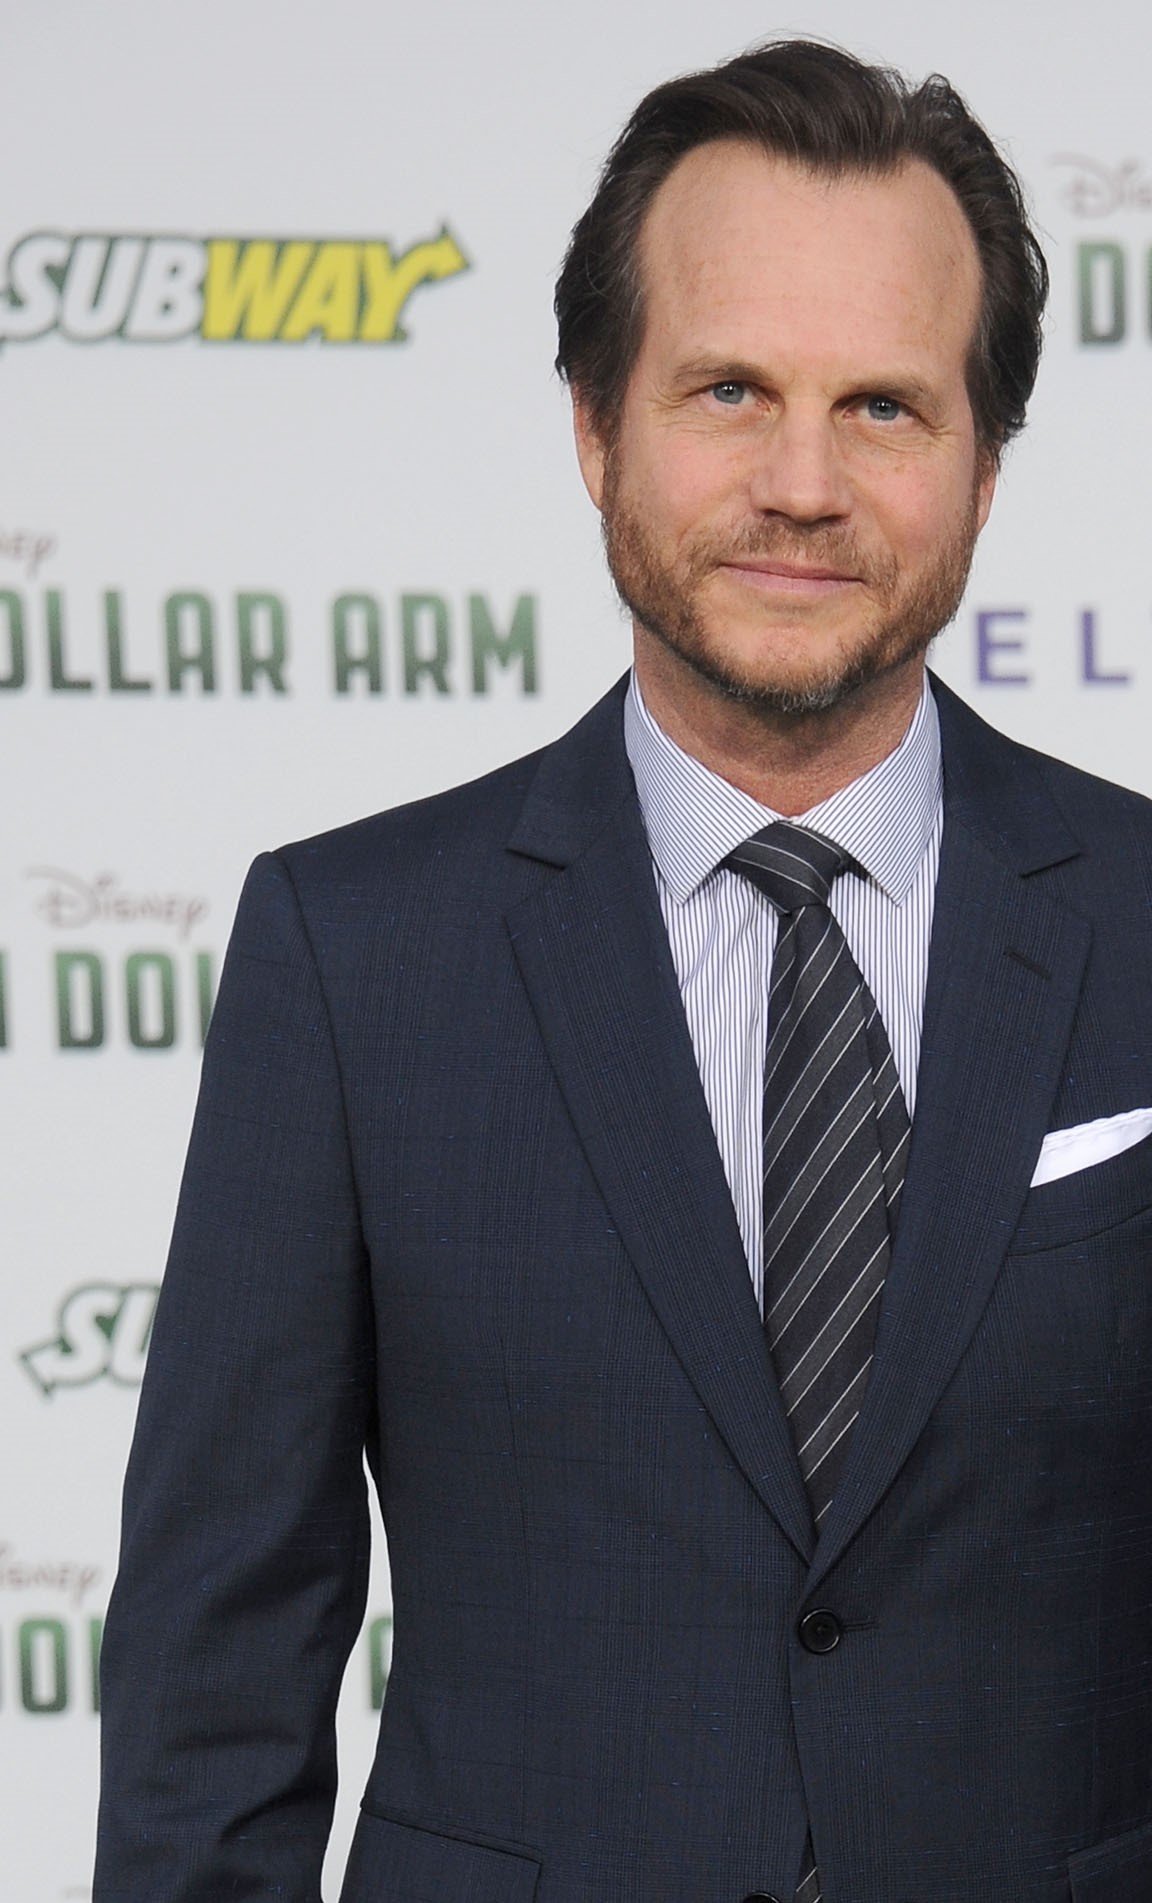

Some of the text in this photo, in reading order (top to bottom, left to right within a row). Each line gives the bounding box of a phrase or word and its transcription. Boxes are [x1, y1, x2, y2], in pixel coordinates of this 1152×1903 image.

[0, 222, 474, 348] SUBWAY
[330, 590, 541, 696] ARM
[22, 866, 206, 942] Disney
